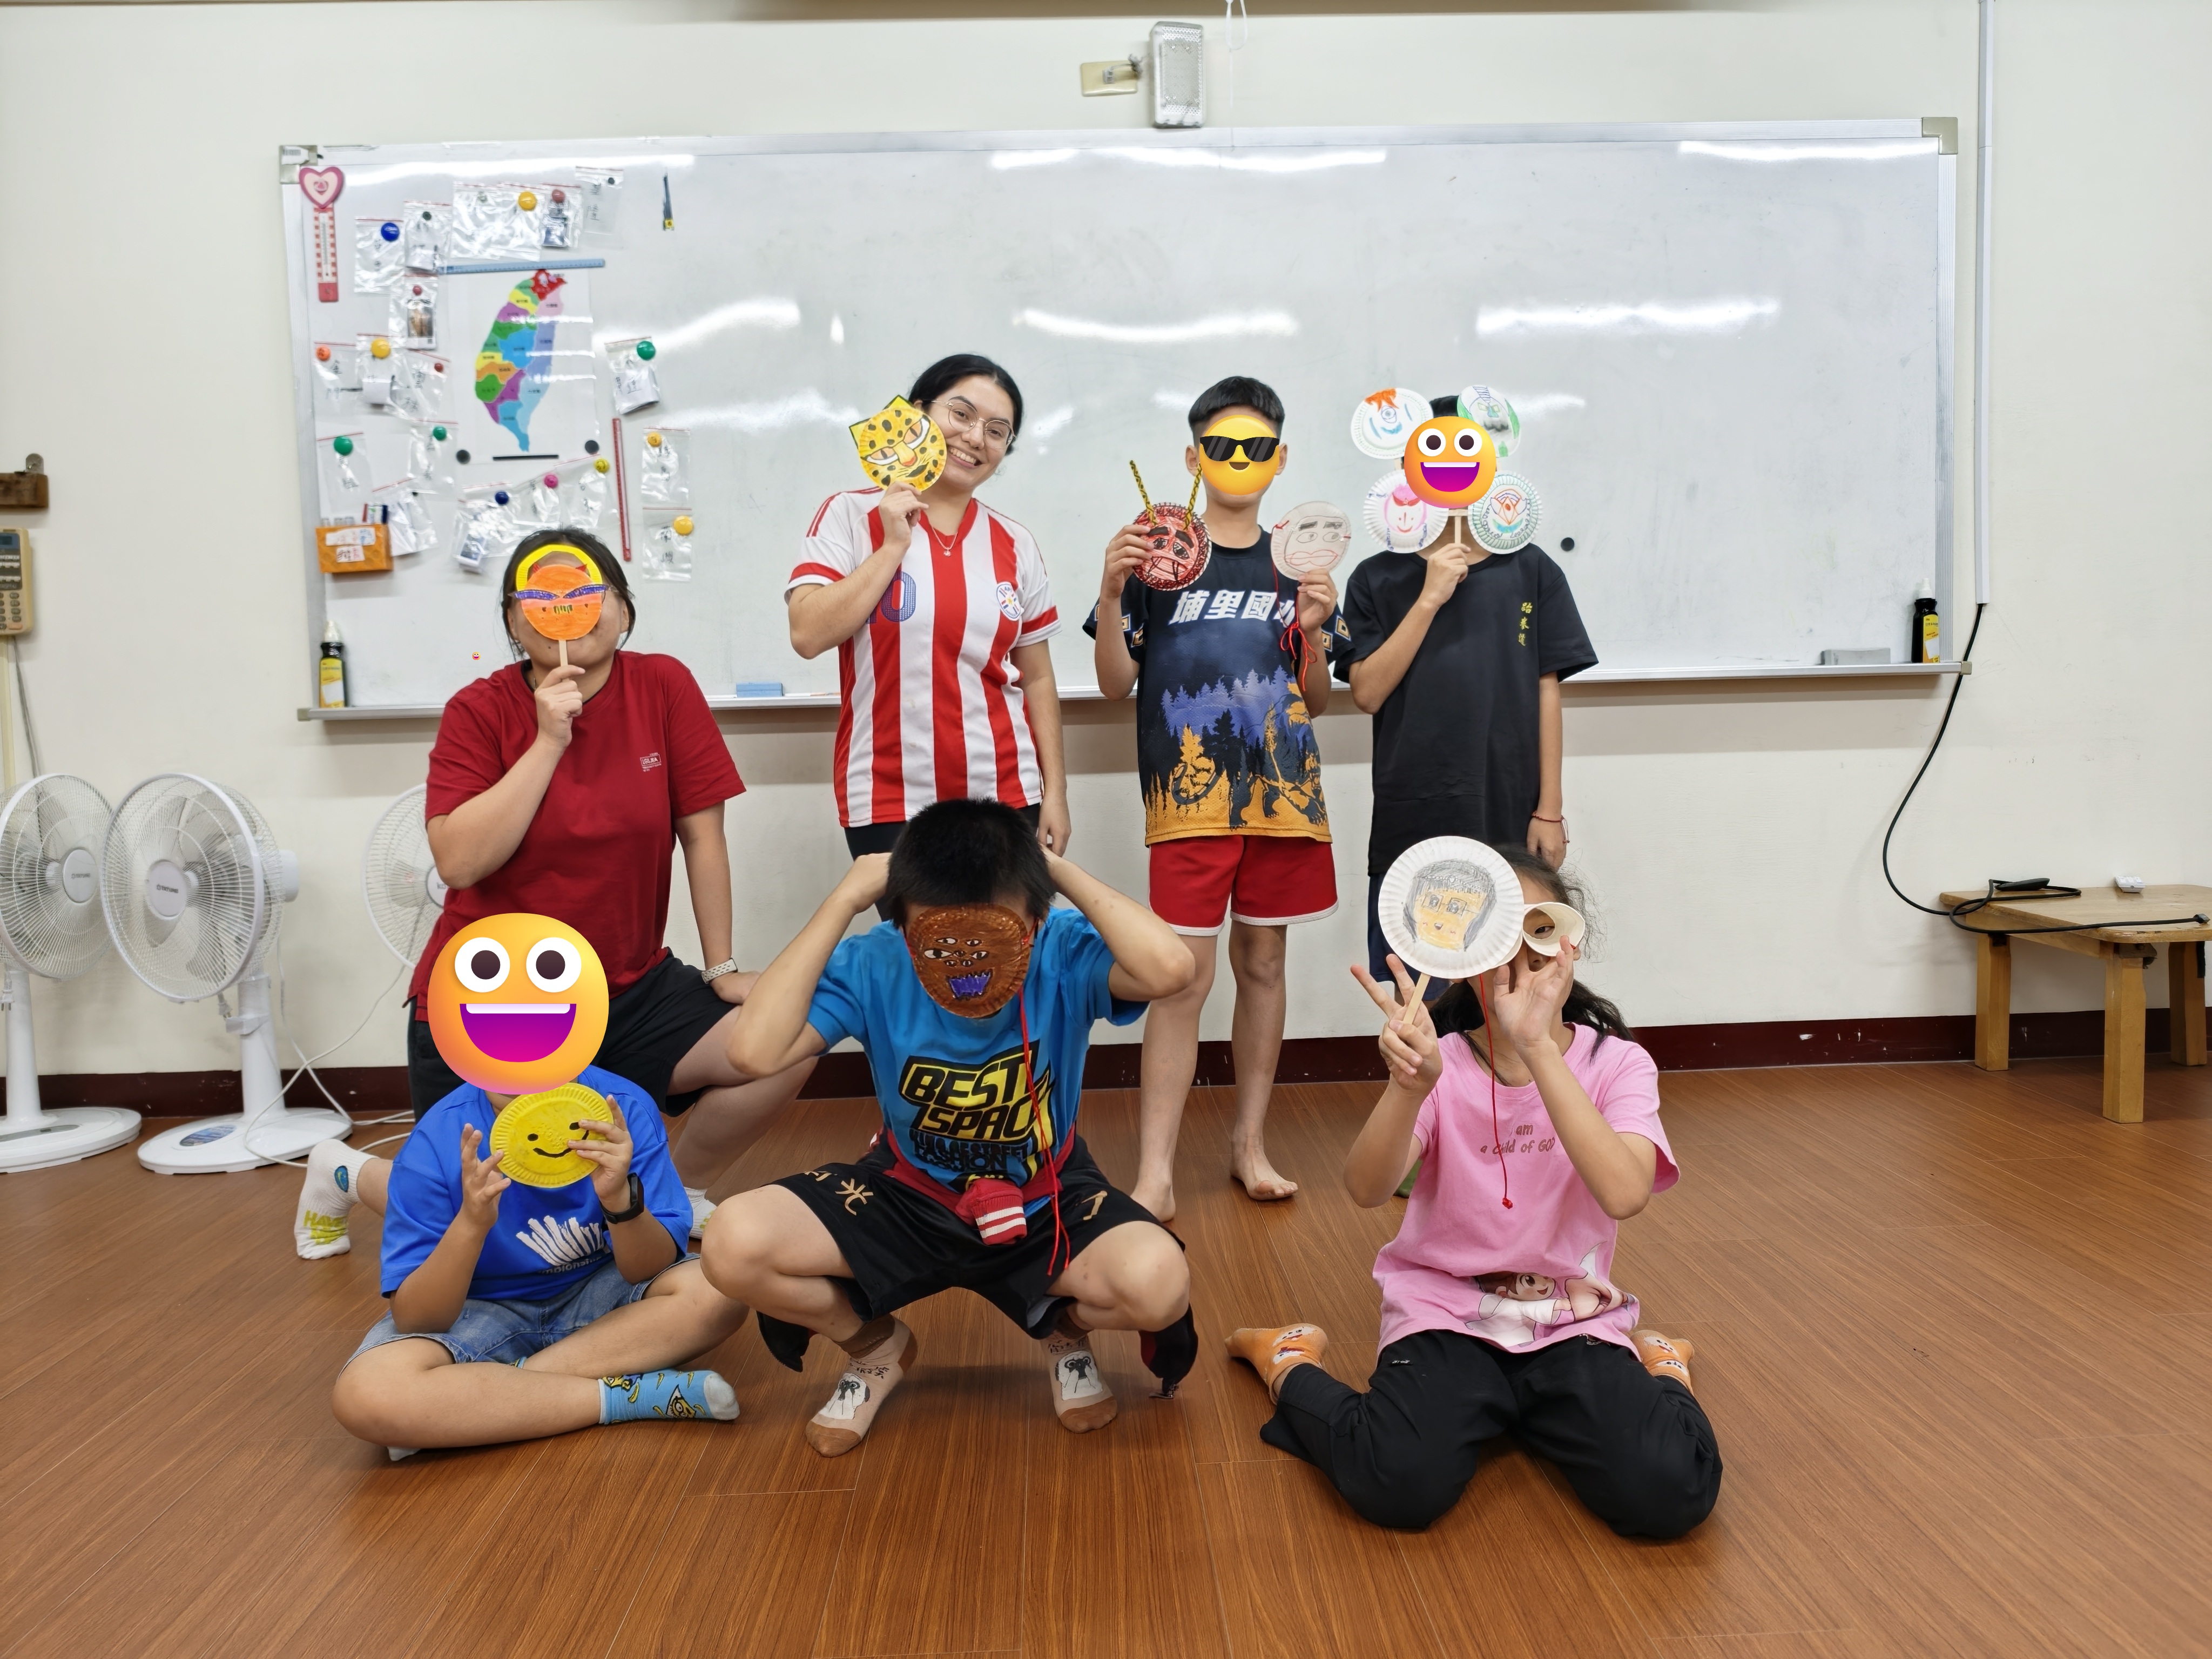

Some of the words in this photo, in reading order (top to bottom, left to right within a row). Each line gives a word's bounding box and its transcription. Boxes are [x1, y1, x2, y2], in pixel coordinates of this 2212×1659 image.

[903, 1051, 1033, 1110] BEST
[1515, 1124, 1533, 1136] am
[1480, 1144, 1488, 1154] a
[1520, 1139, 1535, 1154] of
